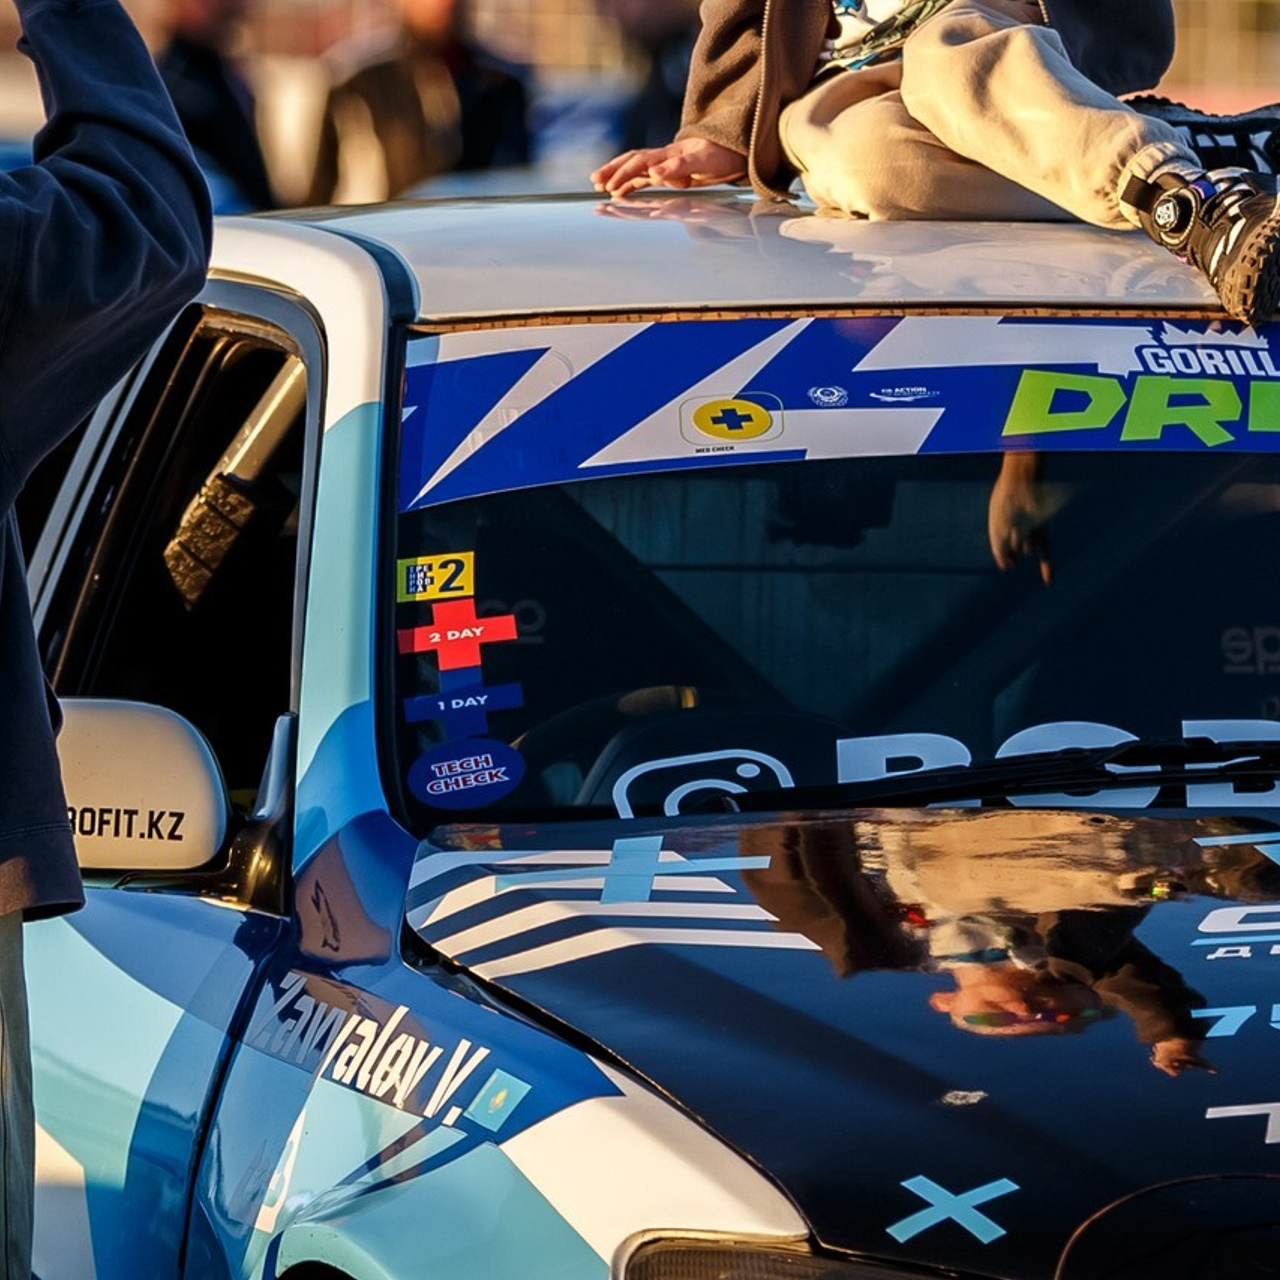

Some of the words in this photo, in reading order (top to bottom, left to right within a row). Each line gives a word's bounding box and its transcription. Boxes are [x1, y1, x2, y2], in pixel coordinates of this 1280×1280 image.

[438, 559, 466, 593] 2
[429, 632, 441, 643] 2
[447, 626, 485, 641] DAY
[437, 701, 446, 711] 1
[451, 695, 488, 709] DAY
[431, 754, 493, 777] TECH
[426, 767, 509, 794] CHECK
[422, 1038, 491, 1126] V.
